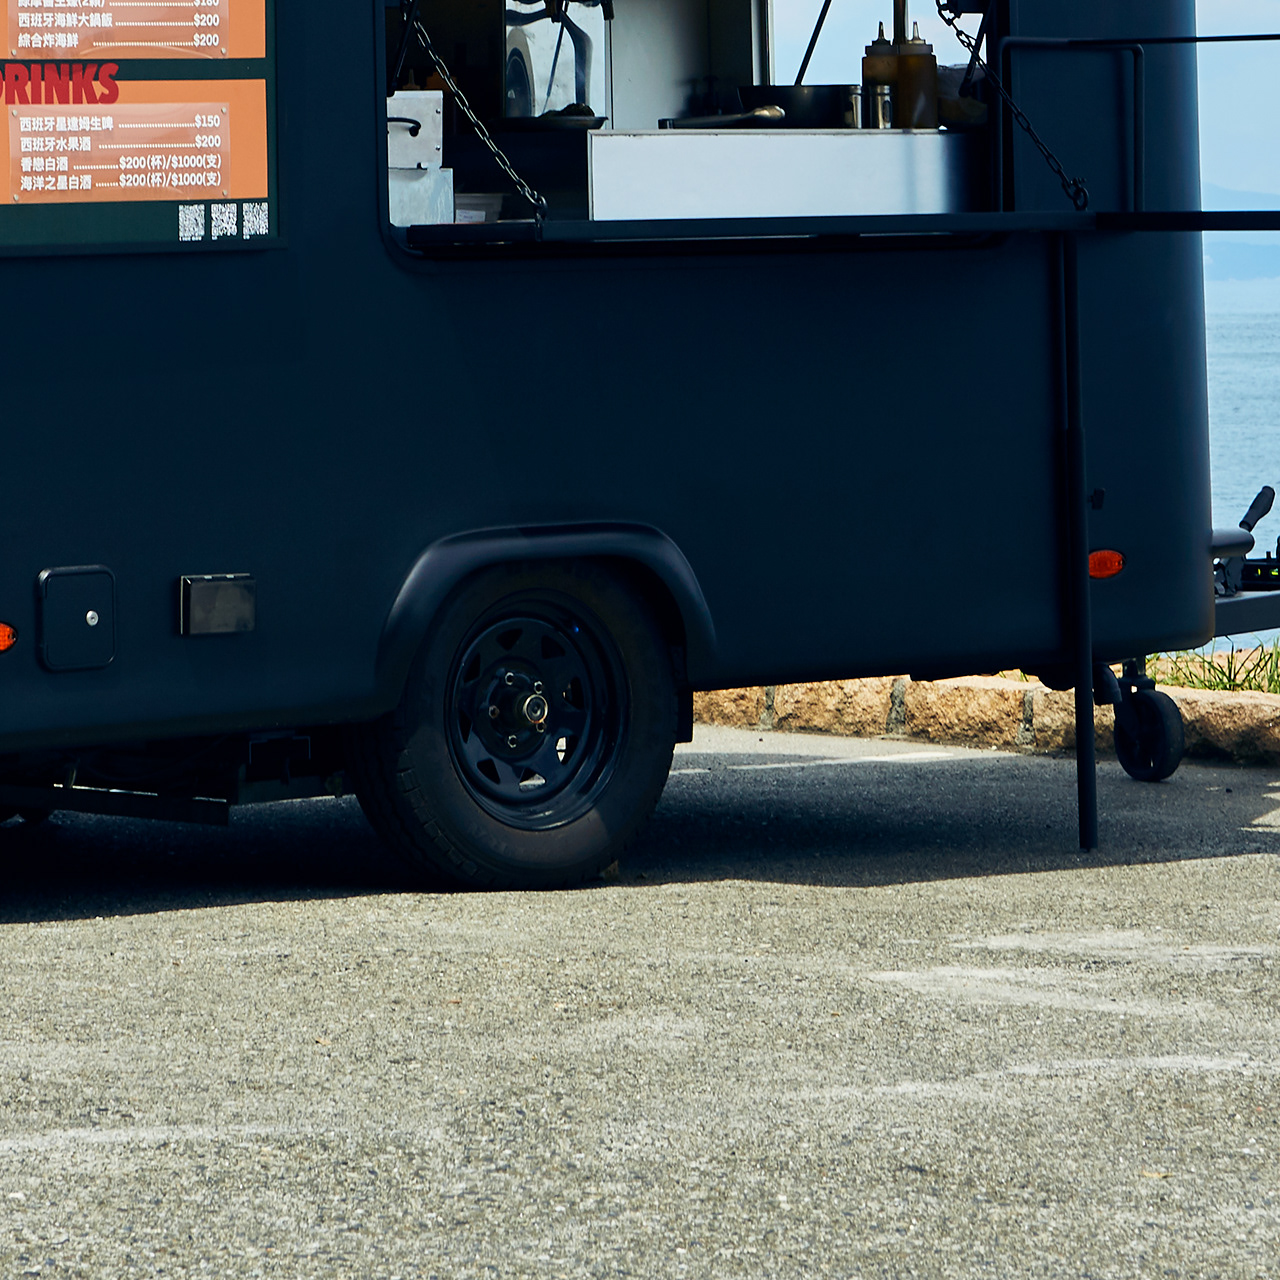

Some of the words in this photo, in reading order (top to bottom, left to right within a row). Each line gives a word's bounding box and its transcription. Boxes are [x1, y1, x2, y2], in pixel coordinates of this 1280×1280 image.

[193, 13, 220, 27] $200
[193, 33, 220, 47] $200
[194, 114, 220, 128] $150
[20, 136, 91, 152] 西班牙水果酒
[194, 134, 221, 148] $200
